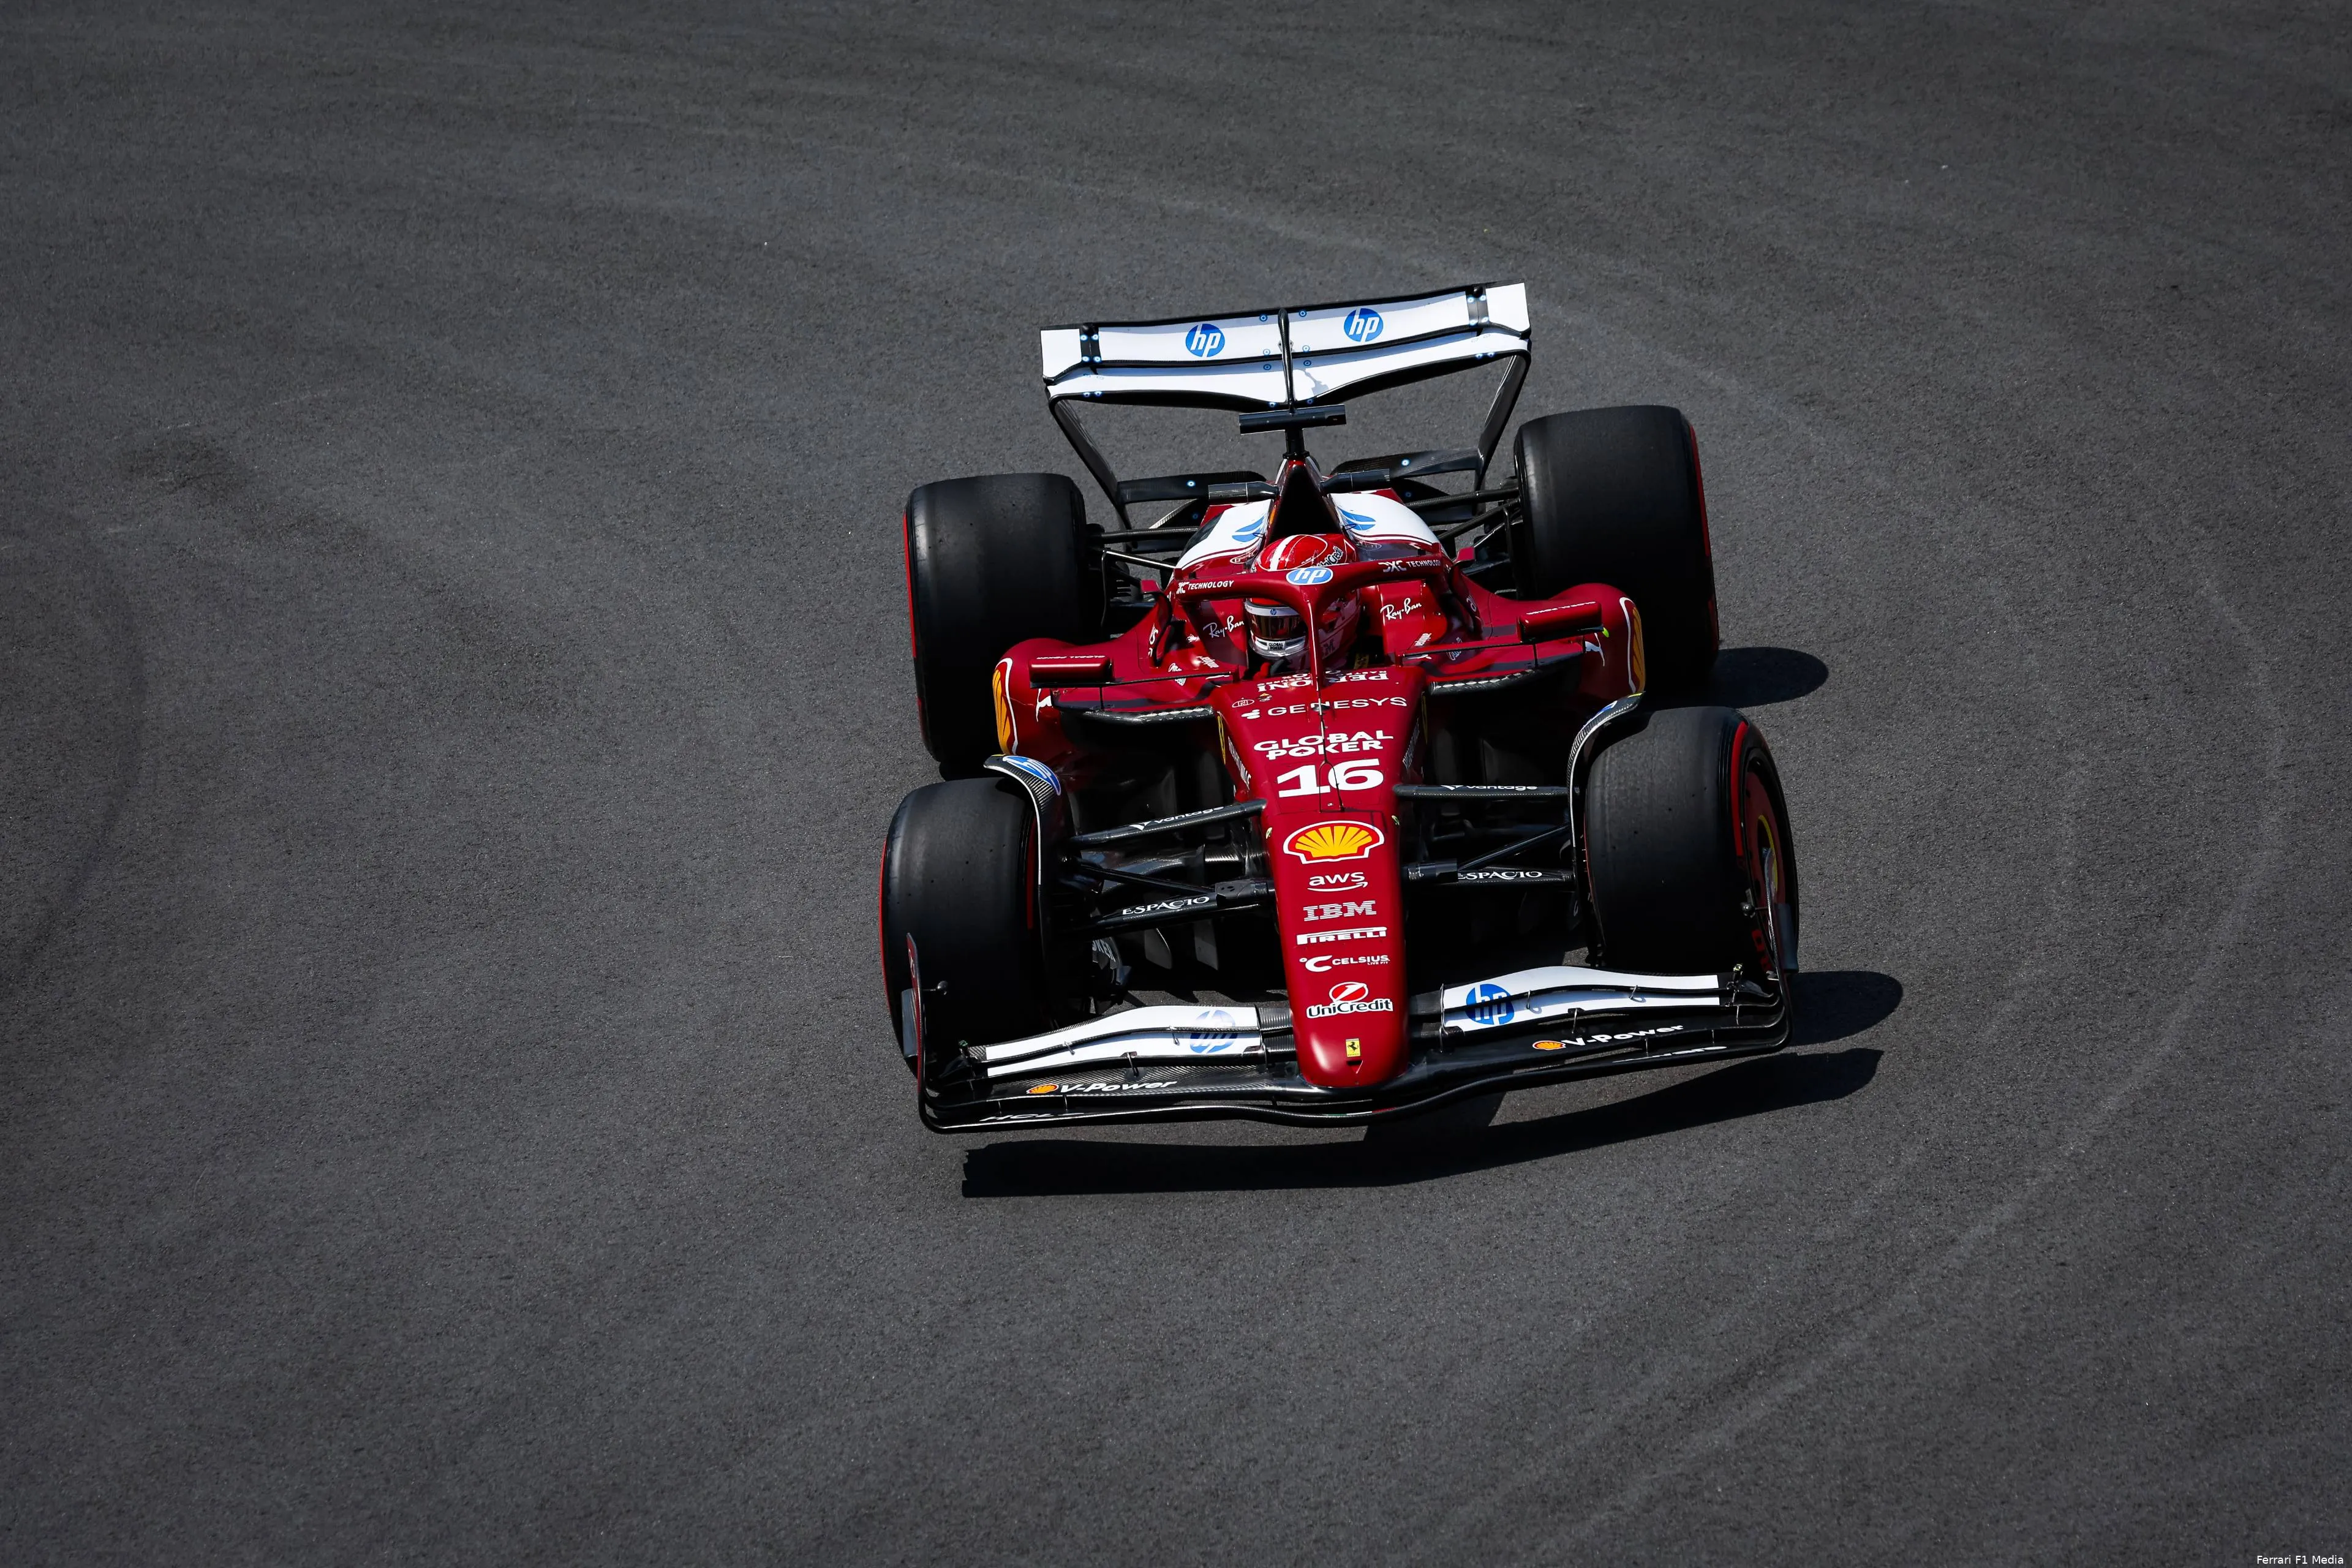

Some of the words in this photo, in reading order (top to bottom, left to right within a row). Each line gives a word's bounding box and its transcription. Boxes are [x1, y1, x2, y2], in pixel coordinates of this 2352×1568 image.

[1348, 308, 1380, 342] hp
[1189, 323, 1221, 357] hp
[1188, 581, 1234, 590] TECHNOLOGY
[1293, 568, 1328, 584] hp
[1268, 697, 1408, 716] GENESYS
[1254, 730, 1393, 751] GLOBAL
[1266, 741, 1384, 760] POKER
[1277, 759, 1384, 797] 16
[1154, 806, 1225, 823] vantage
[1308, 872, 1365, 887] aws
[1122, 896, 1210, 914] ESPACIO
[1303, 900, 1377, 921] IBM
[1297, 927, 1387, 945] PIRELLI
[1332, 955, 1389, 965] CELSIUS
[1307, 1000, 1393, 1019] UniCredit
[1473, 984, 1508, 1025] hp
[1561, 1025, 1683, 1046] V-Power
[1061, 1081, 1177, 1093] V-Power
